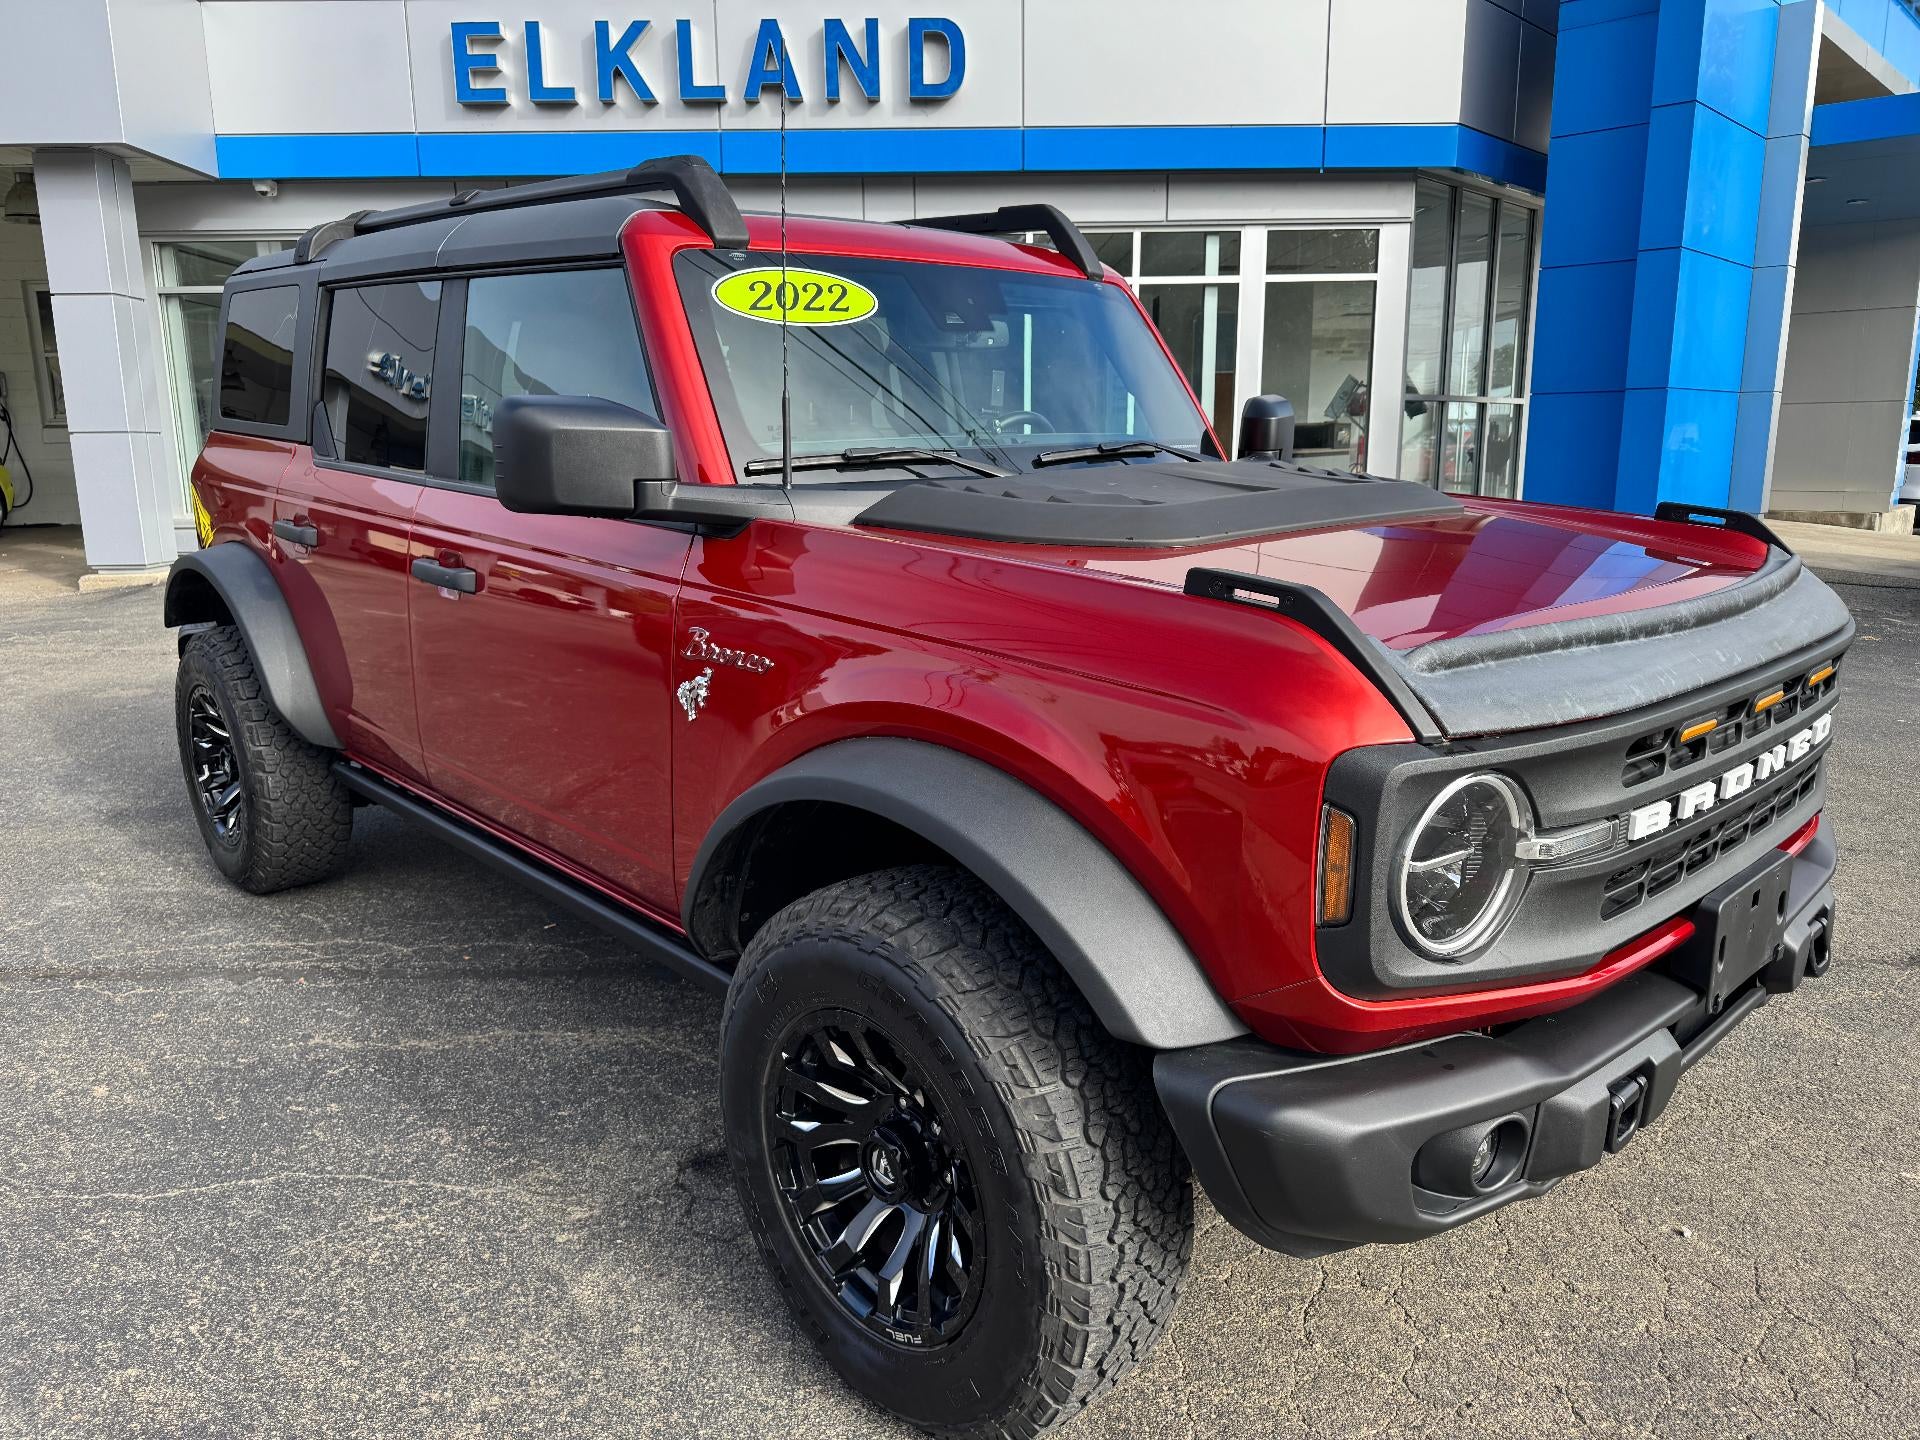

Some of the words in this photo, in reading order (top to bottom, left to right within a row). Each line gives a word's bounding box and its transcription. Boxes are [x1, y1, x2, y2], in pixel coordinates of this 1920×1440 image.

[450, 17, 967, 105] ELKLAND
[748, 280, 851, 313] 2022
[680, 626, 775, 674] Bronco
[1627, 711, 1833, 841] BRONCO
[885, 1327, 923, 1344] FUEL
